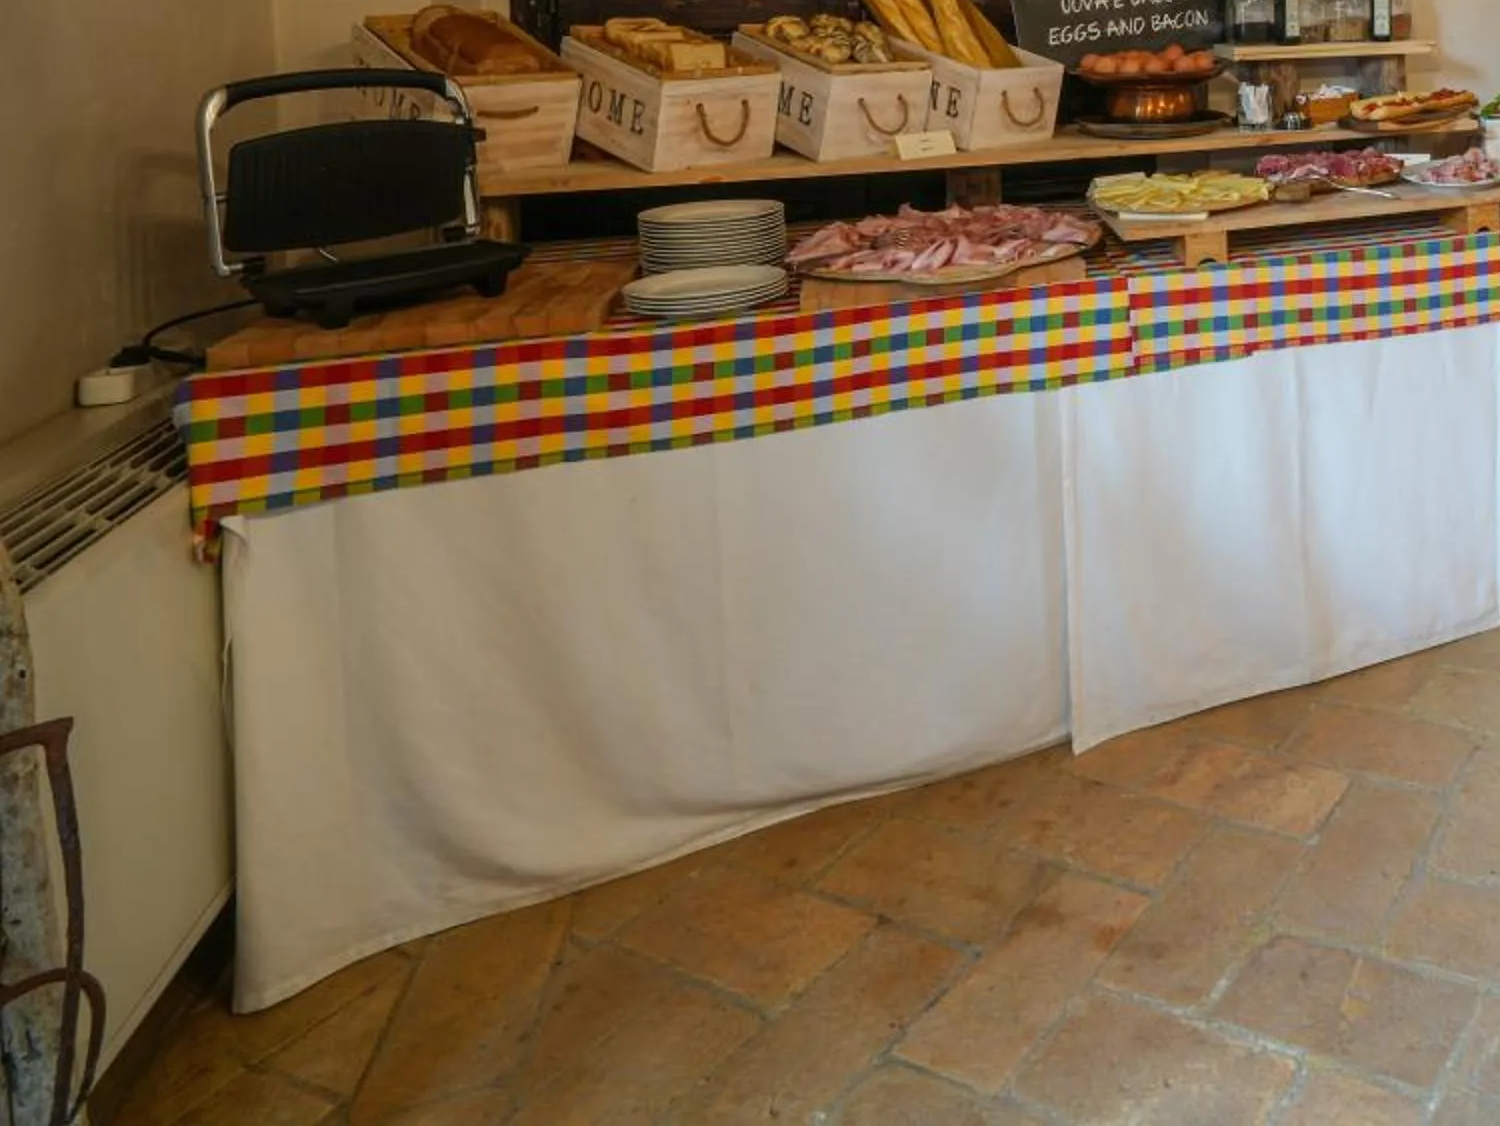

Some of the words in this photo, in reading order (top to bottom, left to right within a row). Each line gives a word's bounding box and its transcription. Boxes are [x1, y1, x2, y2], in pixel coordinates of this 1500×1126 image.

[1048, 21, 1101, 45] EGGS
[1106, 17, 1145, 37] AND
[1151, 11, 1209, 32] BACON
[581, 77, 646, 135] OME
[777, 81, 813, 125] ME
